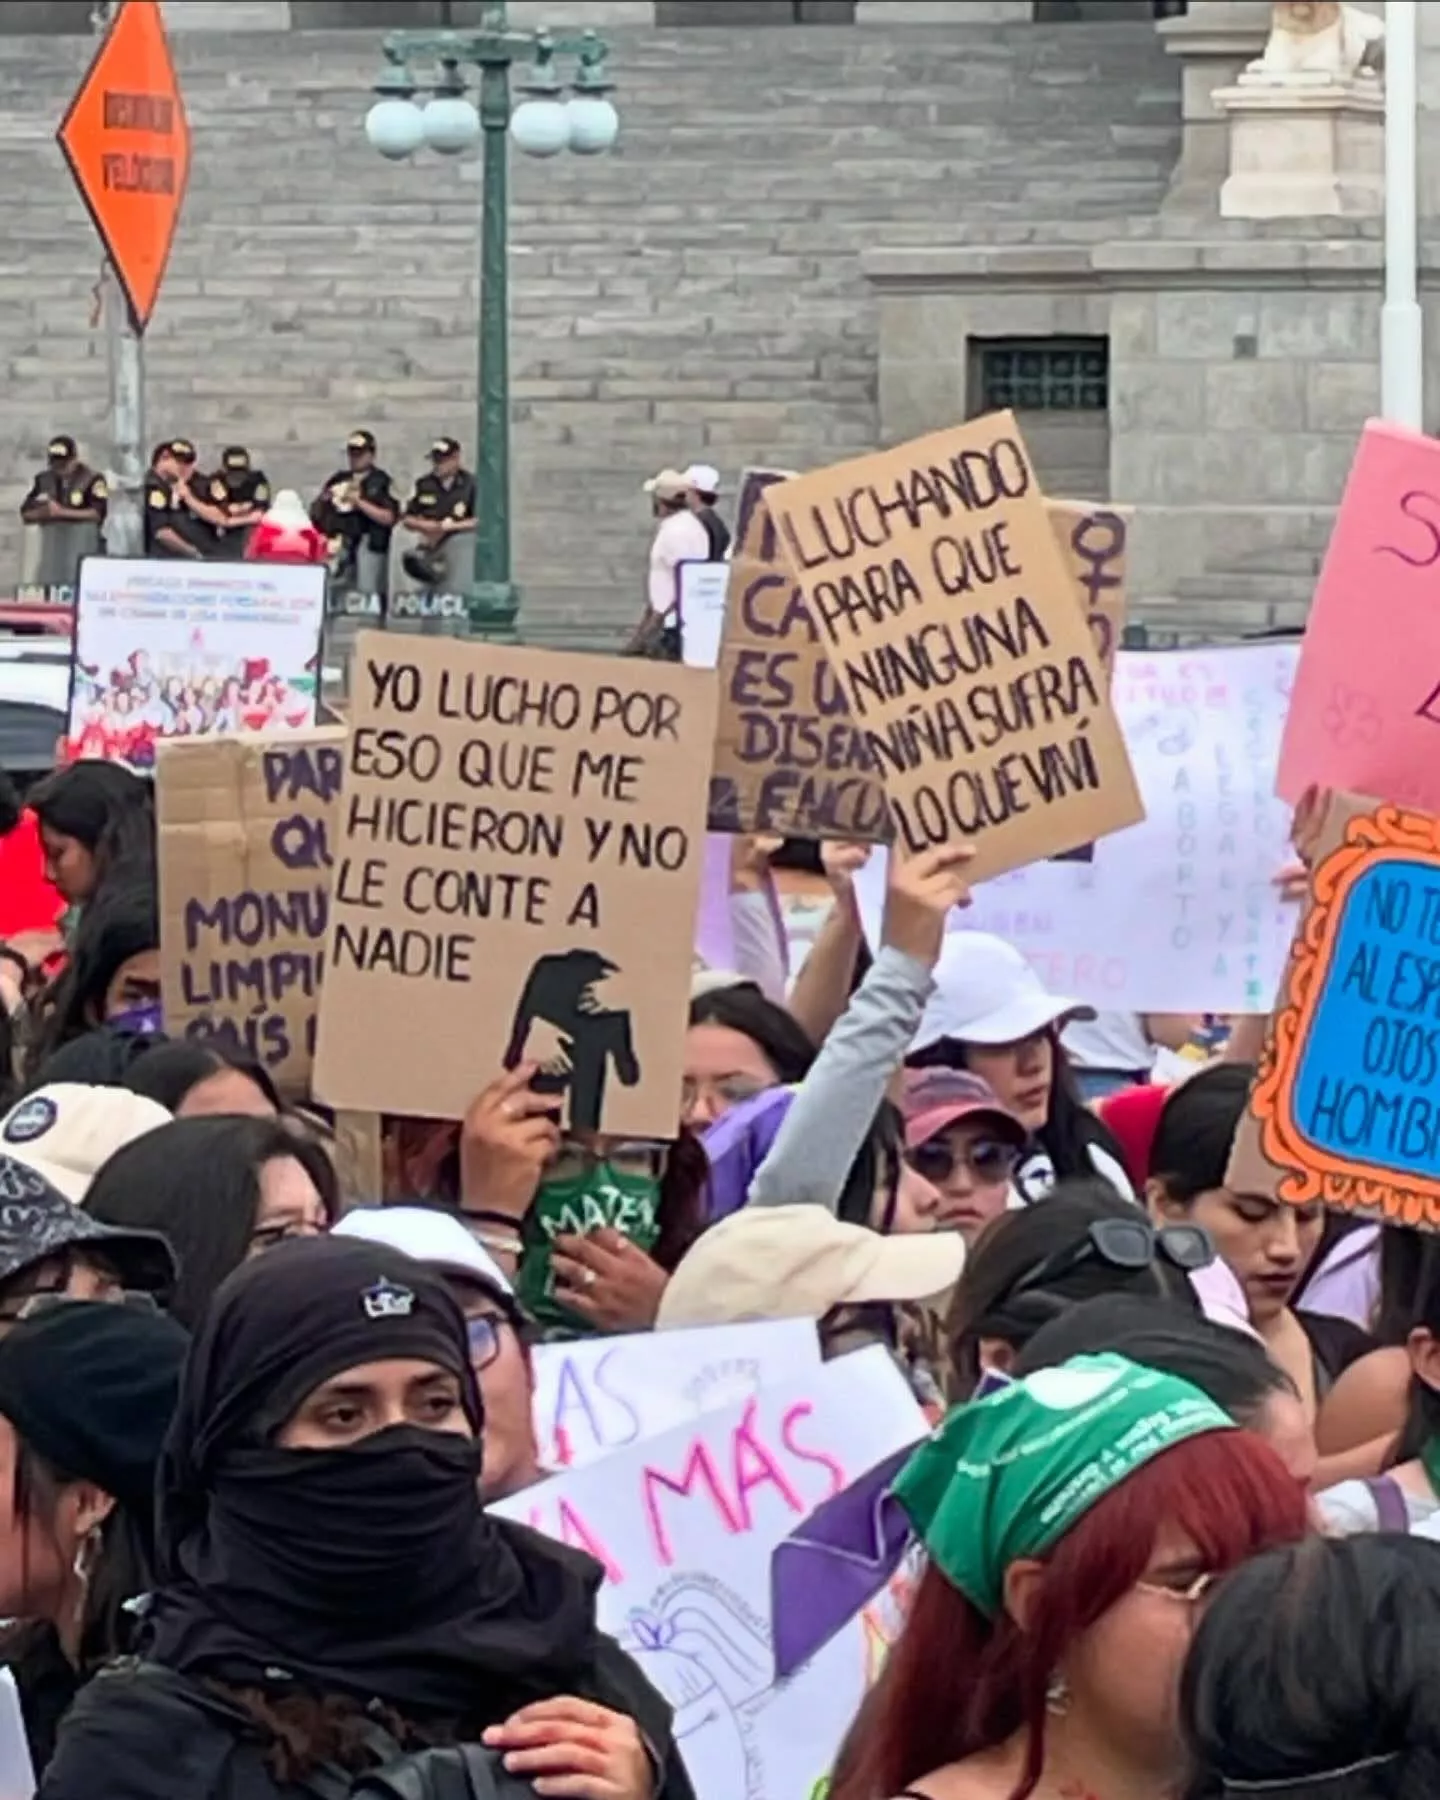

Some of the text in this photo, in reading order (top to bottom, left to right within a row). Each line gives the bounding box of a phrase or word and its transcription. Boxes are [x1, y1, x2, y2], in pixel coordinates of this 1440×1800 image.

[781, 438, 1029, 569] LUCHANDO
[812, 558, 923, 646] PARA
[930, 521, 1022, 597] QUE
[730, 650, 800, 709] ES
[843, 597, 1050, 716] NINGUNA
[367, 659, 683, 743] YO LUCHO POR
[864, 697, 975, 782] NIÑA
[966, 656, 1100, 748] SUFRA
[350, 727, 646, 803] ESO QUE ME
[891, 785, 949, 854] LO
[948, 752, 1031, 835] QUE
[1019, 717, 1101, 805] VIVÍ
[346, 793, 689, 871] HICIERON Y NO
[335, 858, 600, 930] LE CONTE A
[1364, 876, 1411, 934] NO
[332, 922, 476, 983] NADIE
[1341, 941, 1381, 1006] AL
[1363, 1015, 1440, 1086] OJOS
[641, 1391, 847, 1569] MÁS
